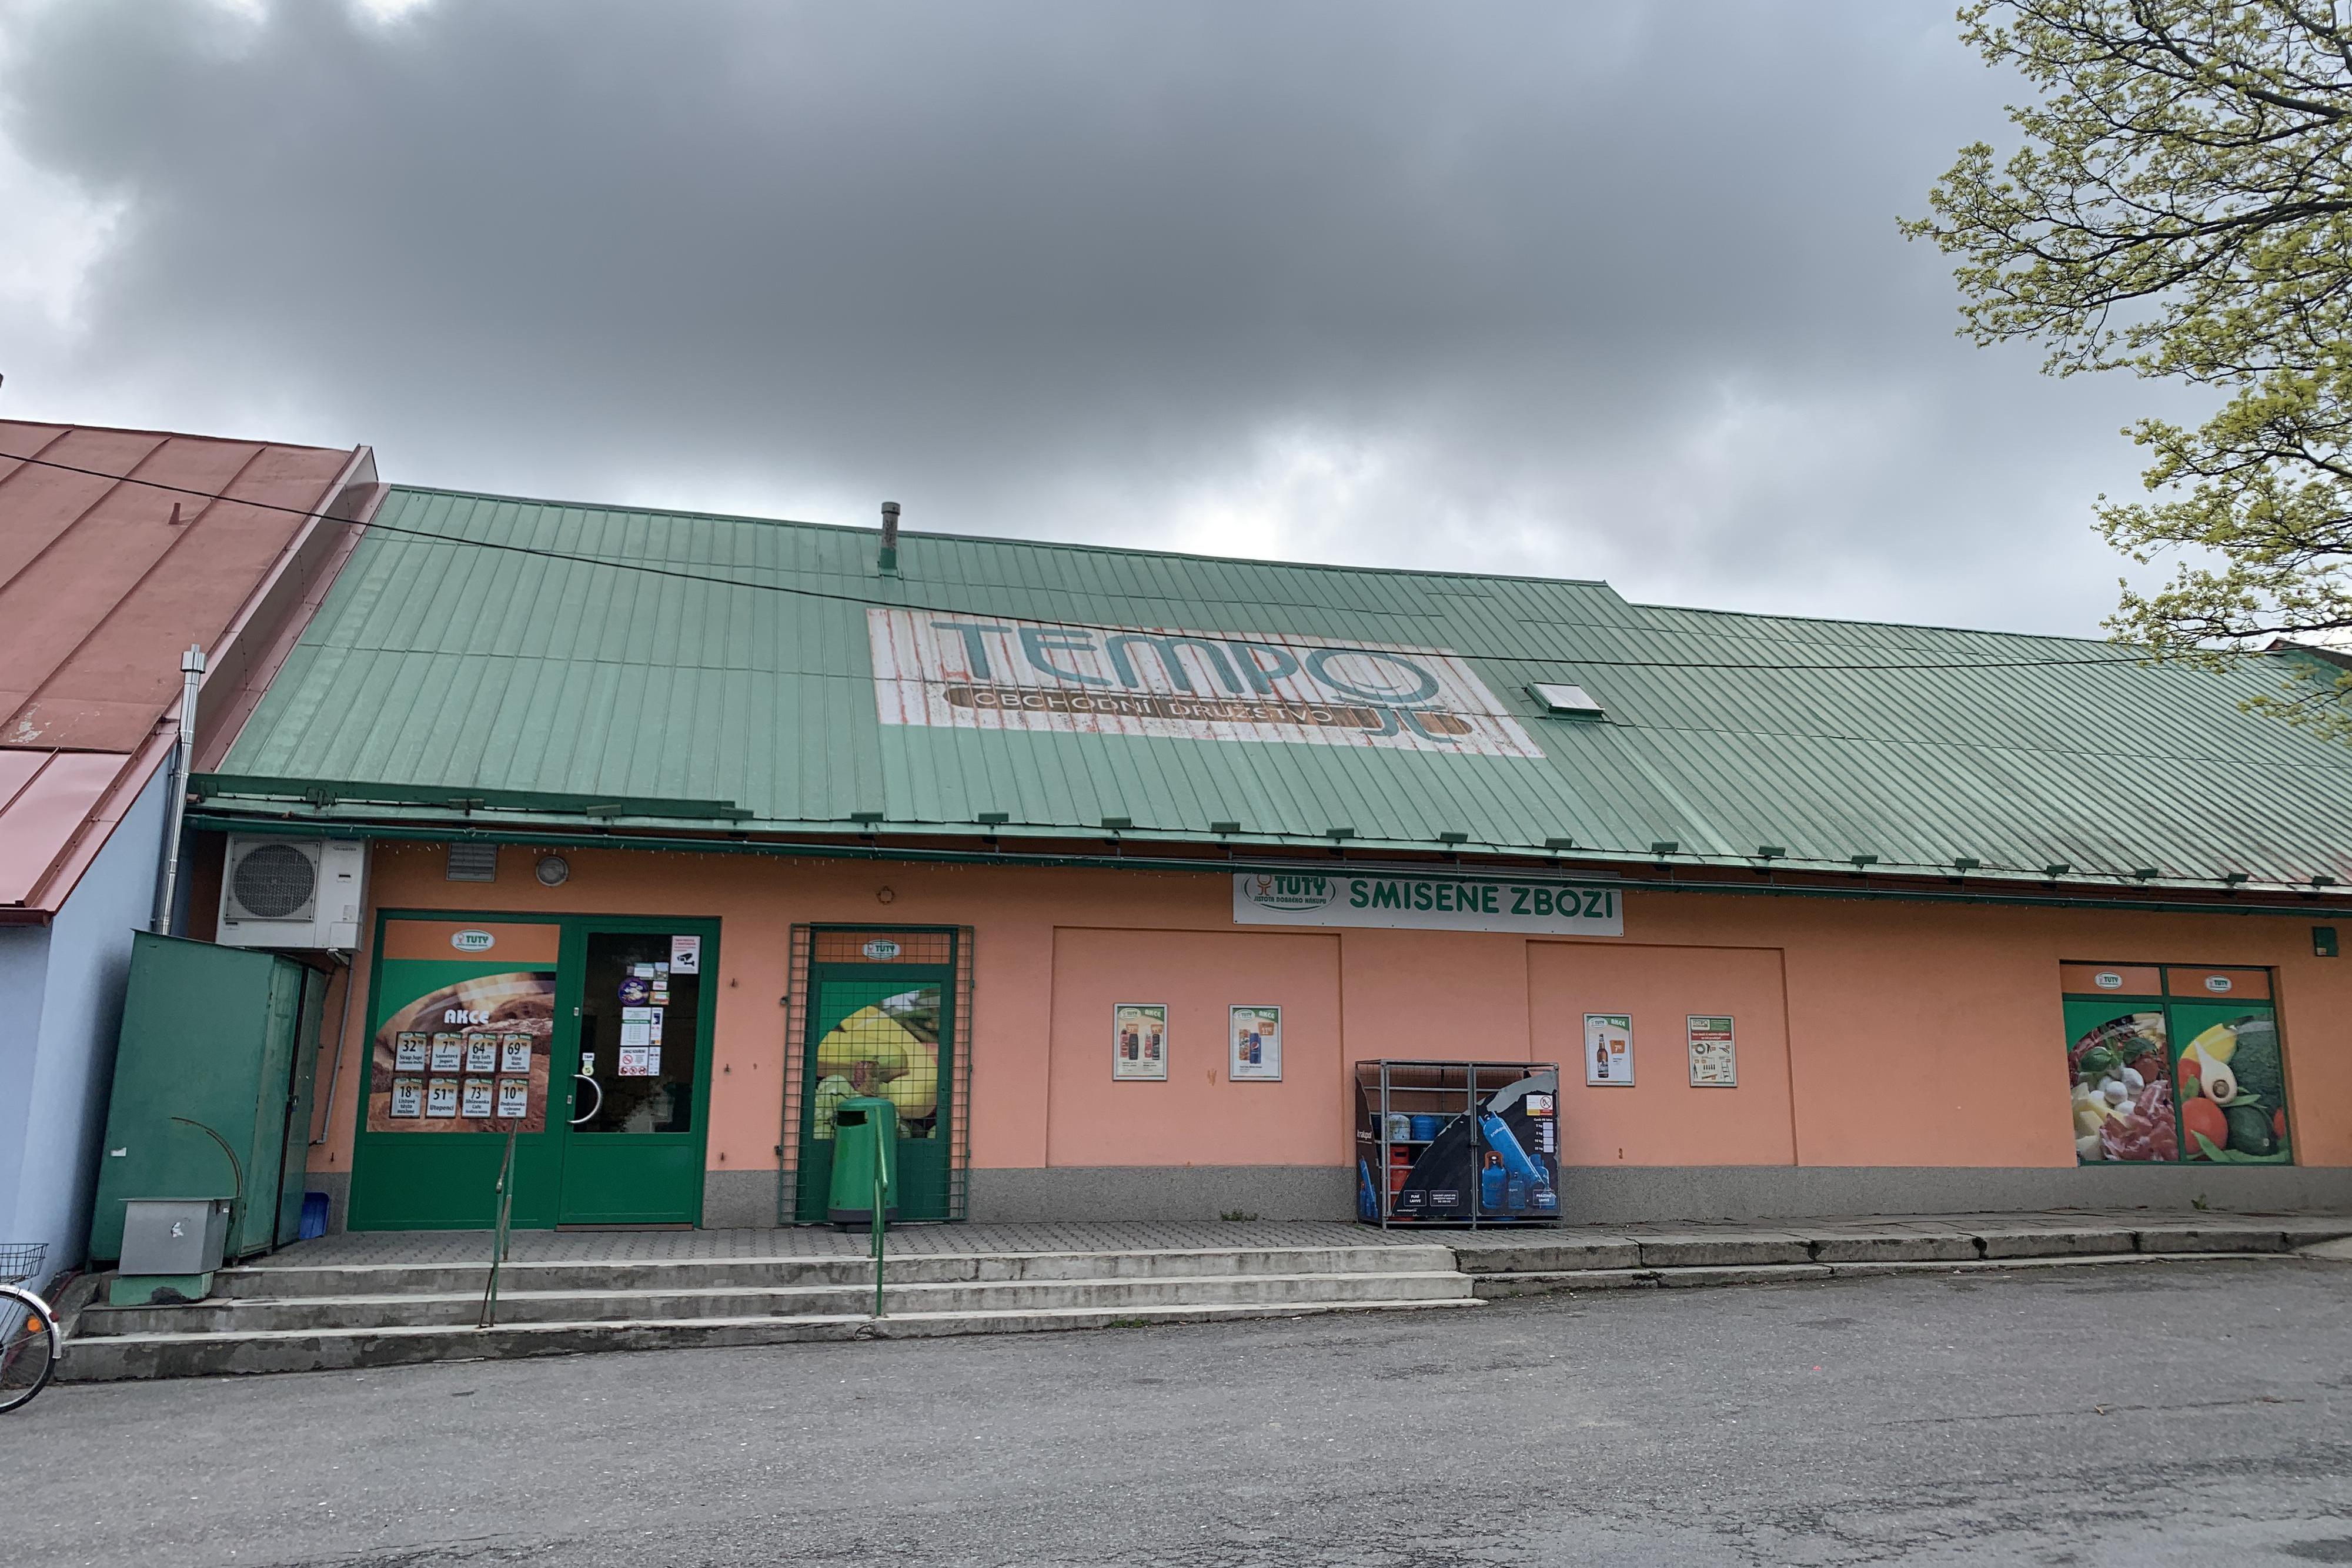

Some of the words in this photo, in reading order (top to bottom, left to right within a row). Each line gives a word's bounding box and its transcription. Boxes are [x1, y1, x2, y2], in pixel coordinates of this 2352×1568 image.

[930, 621, 1439, 703] TEMPO
[974, 693, 1152, 714] OBCHODNÍ
[1168, 703, 1333, 723] DRUŽSTVO
[1274, 875, 1327, 896] TUTY
[444, 1009, 490, 1024] AKCE
[1259, 1011, 1275, 1019] AKCE
[403, 1040, 416, 1052] 32
[443, 1041, 448, 1053] 7
[473, 1042, 485, 1054] 64
[507, 1042, 520, 1055] 69
[400, 1086, 412, 1098] 18
[433, 1089, 446, 1100] 51
[470, 1086, 481, 1099] 73
[504, 1087, 516, 1099] 10
